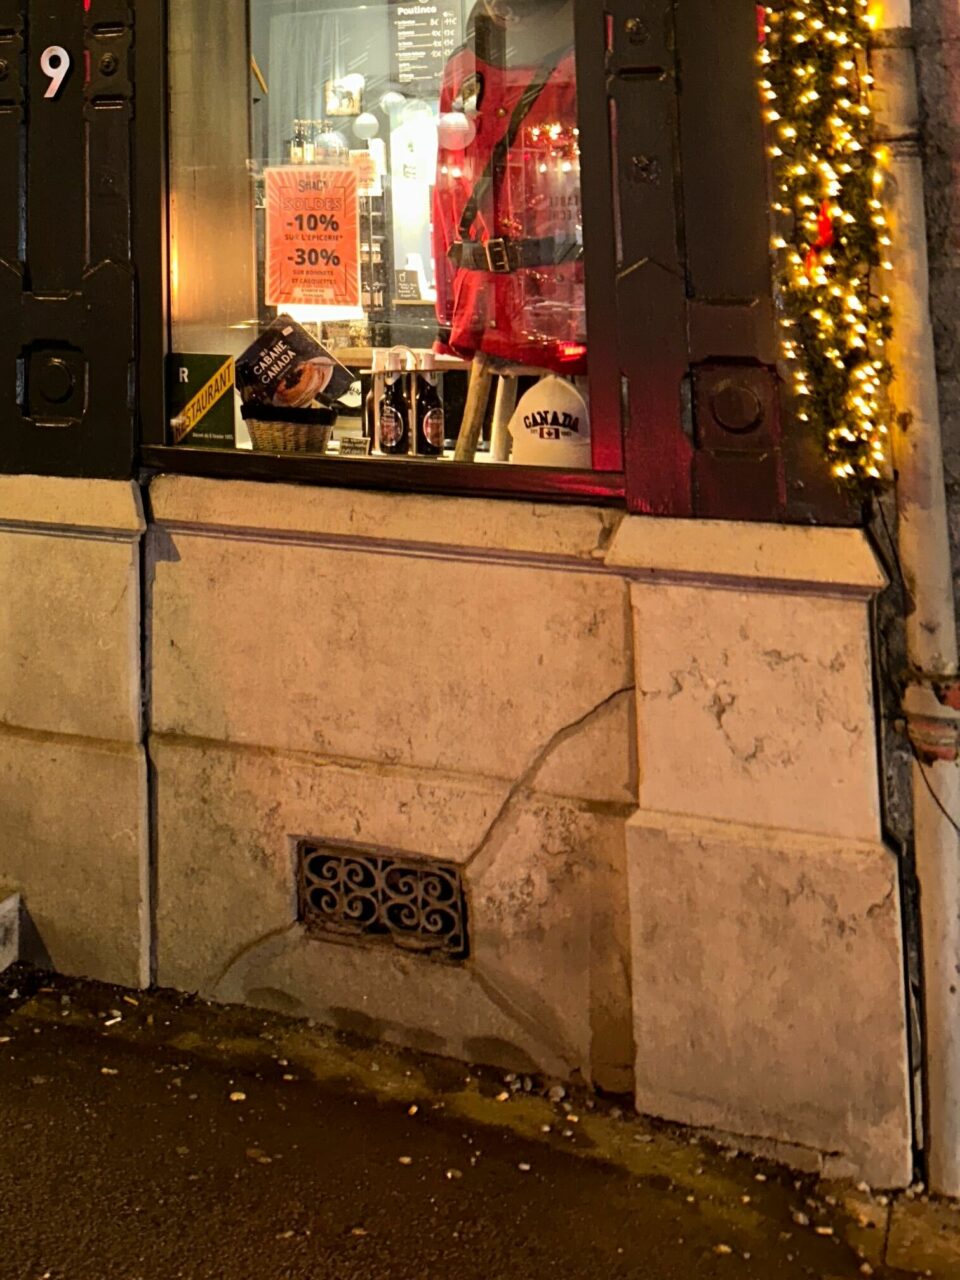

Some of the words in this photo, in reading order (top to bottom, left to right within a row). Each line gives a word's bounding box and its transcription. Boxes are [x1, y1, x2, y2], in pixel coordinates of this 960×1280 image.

[41, 45, 70, 98] 9
[283, 196, 342, 211] SOLDES
[286, 213, 340, 232] -10%
[287, 248, 341, 266] -30%
[253, 340, 290, 376] CABANE
[261, 349, 297, 384] CANADA
[179, 367, 189, 383] R
[523, 410, 579, 433] CANADA
